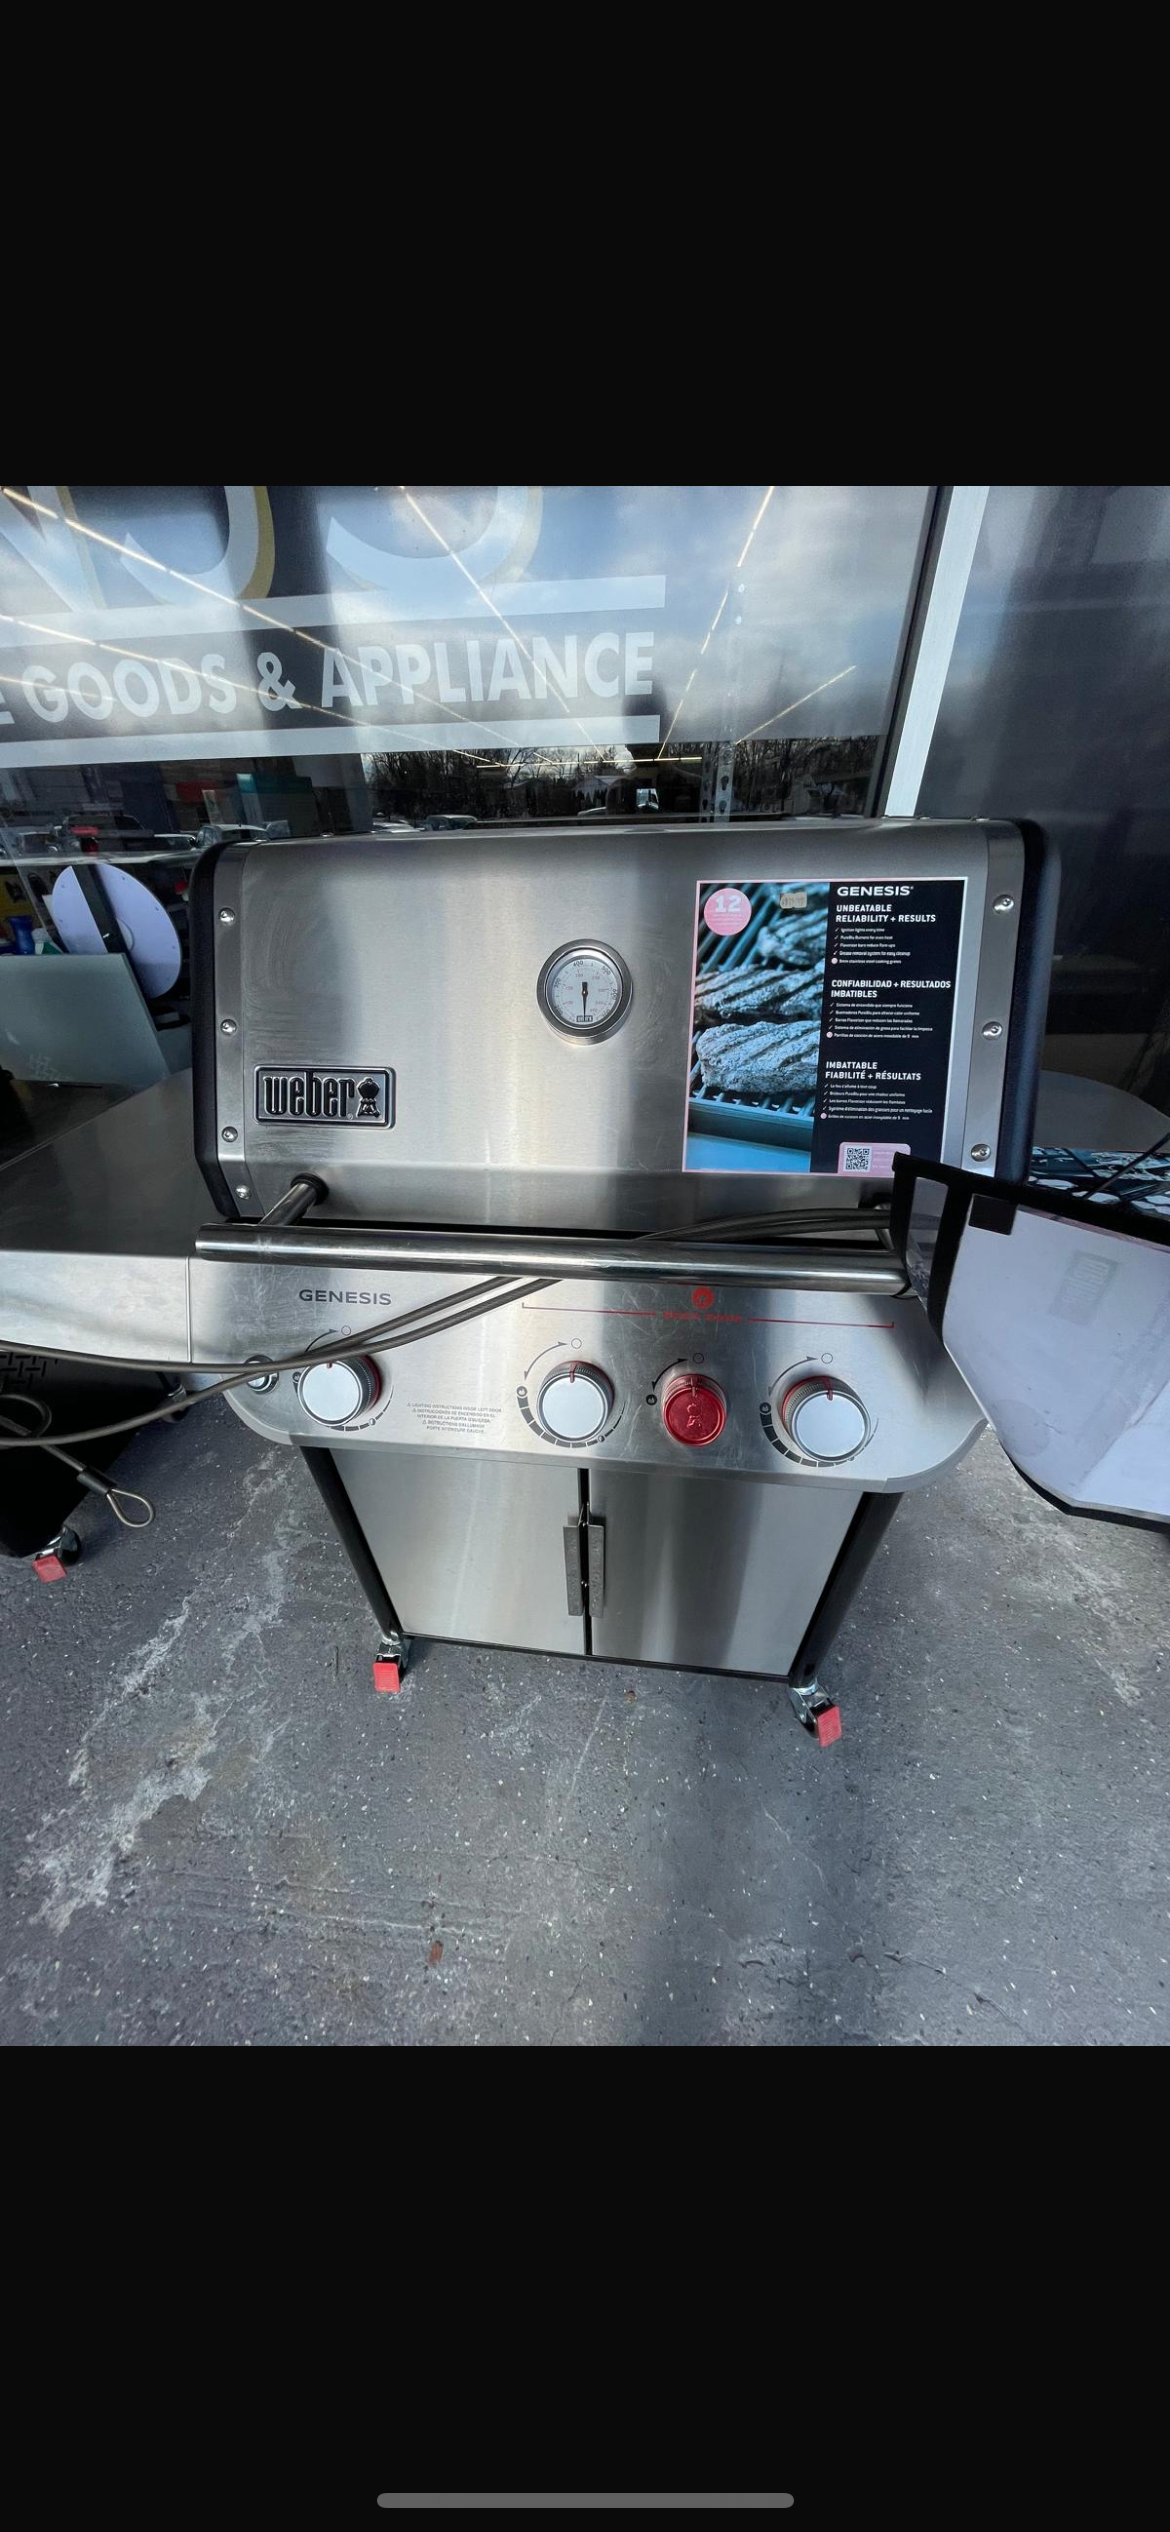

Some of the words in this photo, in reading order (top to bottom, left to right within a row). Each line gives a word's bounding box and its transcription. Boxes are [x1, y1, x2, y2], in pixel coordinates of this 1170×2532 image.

[21, 653, 237, 722] GOODS
[257, 652, 303, 711] &
[321, 632, 655, 707] APPLIANCE
[837, 886, 911, 897] GENESIS
[715, 895, 741, 913] 12
[836, 904, 892, 912] UNBEATABLE
[836, 915, 889, 923] RELIABILITY
[898, 914, 936, 923] RESULTS
[831, 980, 892, 988] CONFIABILIDAD
[900, 980, 951, 988] RESULTADOS
[831, 990, 878, 998] IMBATIBLES
[826, 1061, 878, 1070] IMBATTABLE
[825, 1070, 866, 1079] FIABILITÉ
[875, 1070, 922, 1081] RÉSULTATS
[263, 1070, 355, 1118] weber
[299, 1289, 392, 1305] GENESIS
